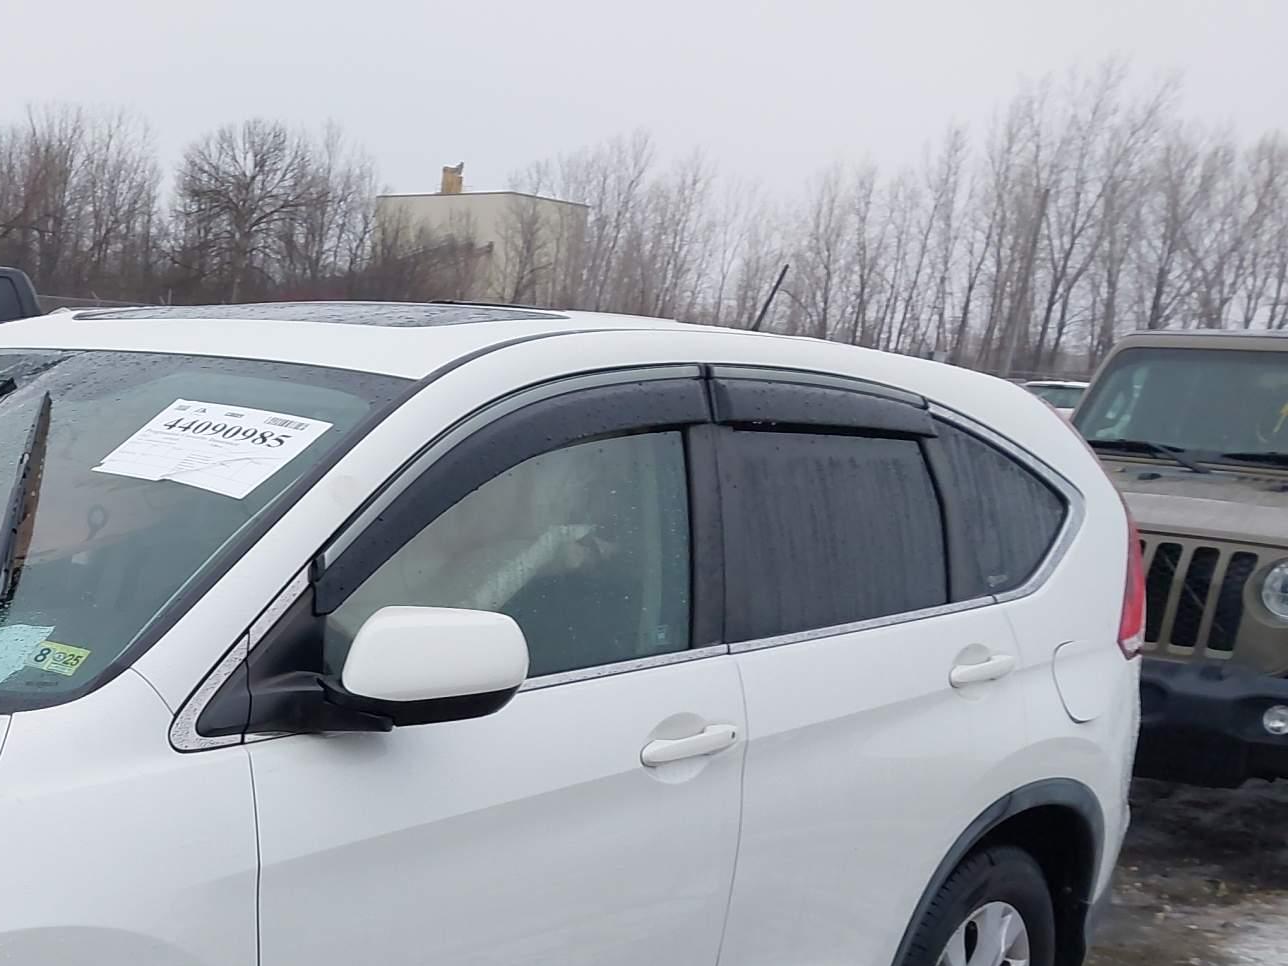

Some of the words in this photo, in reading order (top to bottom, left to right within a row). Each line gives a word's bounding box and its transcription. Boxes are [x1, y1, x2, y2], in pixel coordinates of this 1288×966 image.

[164, 417, 292, 448] 44090985
[34, 648, 51, 662] 8
[62, 653, 83, 666] 25
